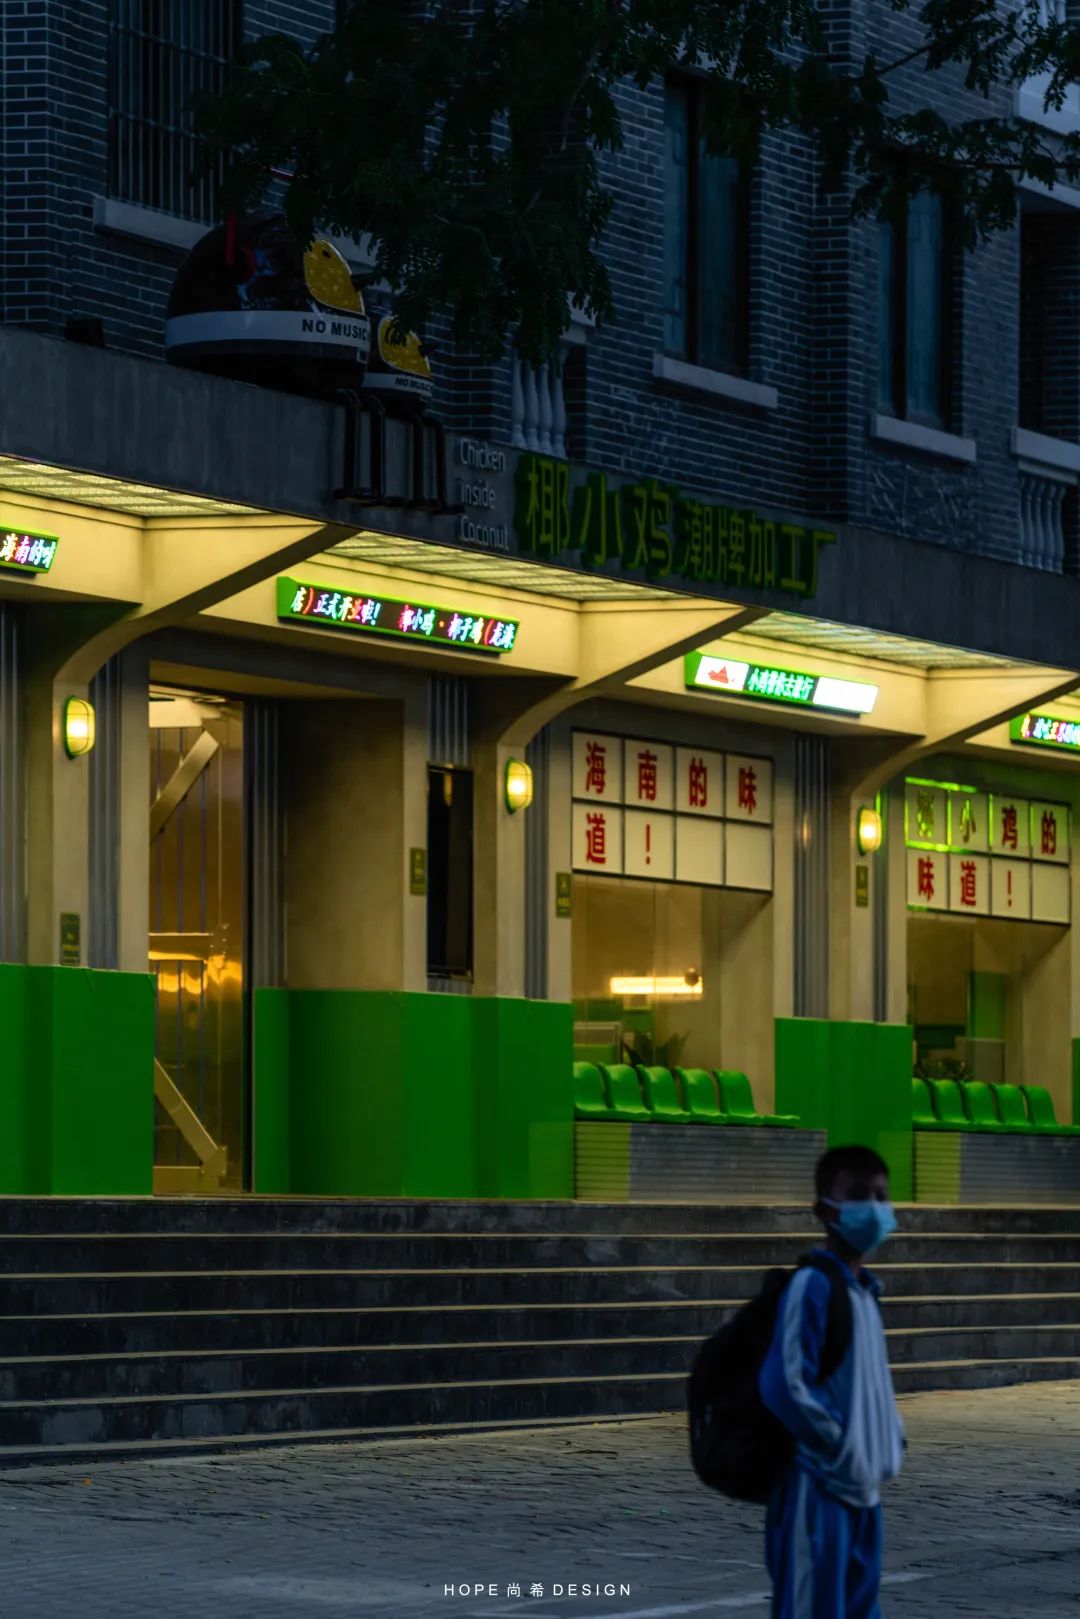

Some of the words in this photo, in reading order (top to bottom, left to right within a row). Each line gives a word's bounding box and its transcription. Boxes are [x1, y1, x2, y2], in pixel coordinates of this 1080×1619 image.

[302, 319, 326, 333] NO
[331, 322, 367, 341] MUSIC
[460, 438, 506, 472] Chicken
[460, 515, 509, 553] Coconut
